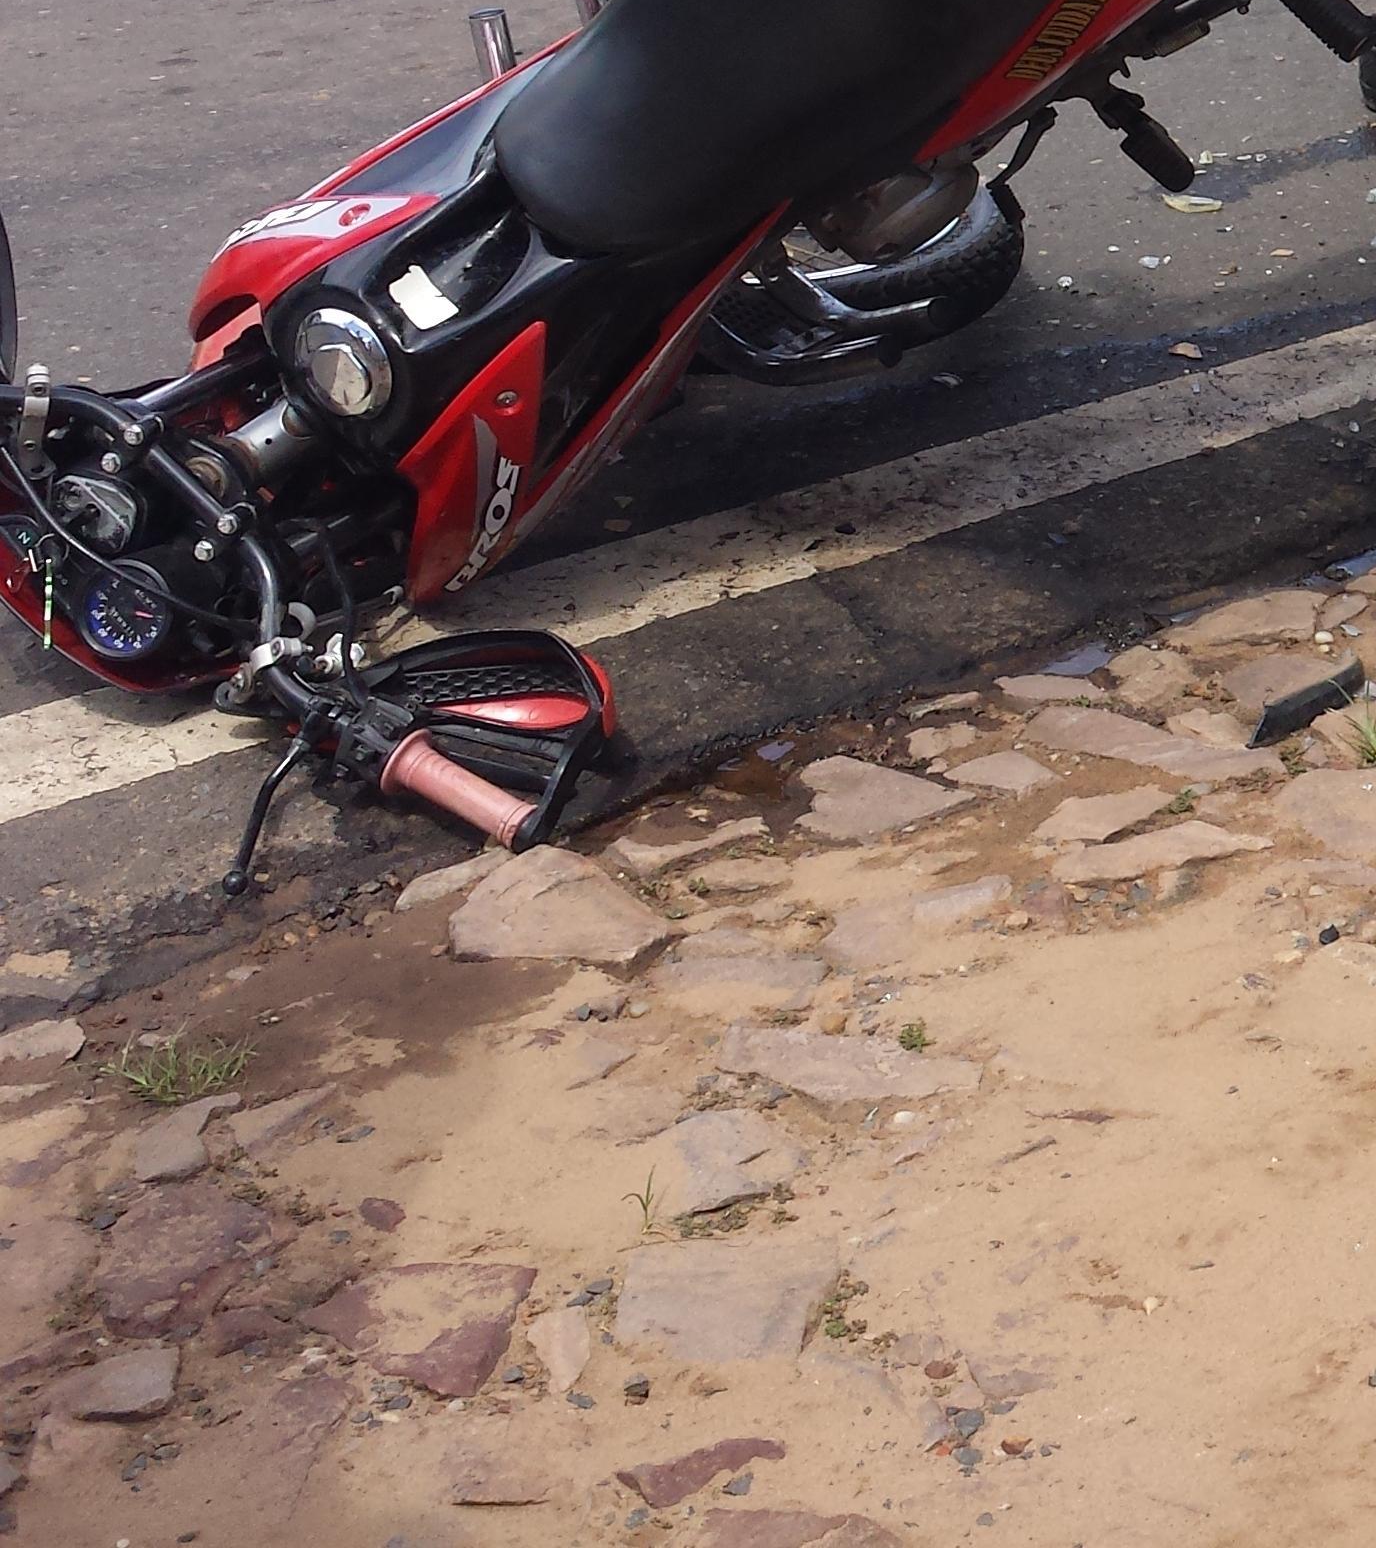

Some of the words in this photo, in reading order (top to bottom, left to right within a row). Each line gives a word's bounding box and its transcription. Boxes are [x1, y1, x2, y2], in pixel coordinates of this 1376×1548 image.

[1004, 42, 1062, 81] DEUS
[1036, 1, 1101, 47] CUIDA
[444, 456, 520, 593] BROS
